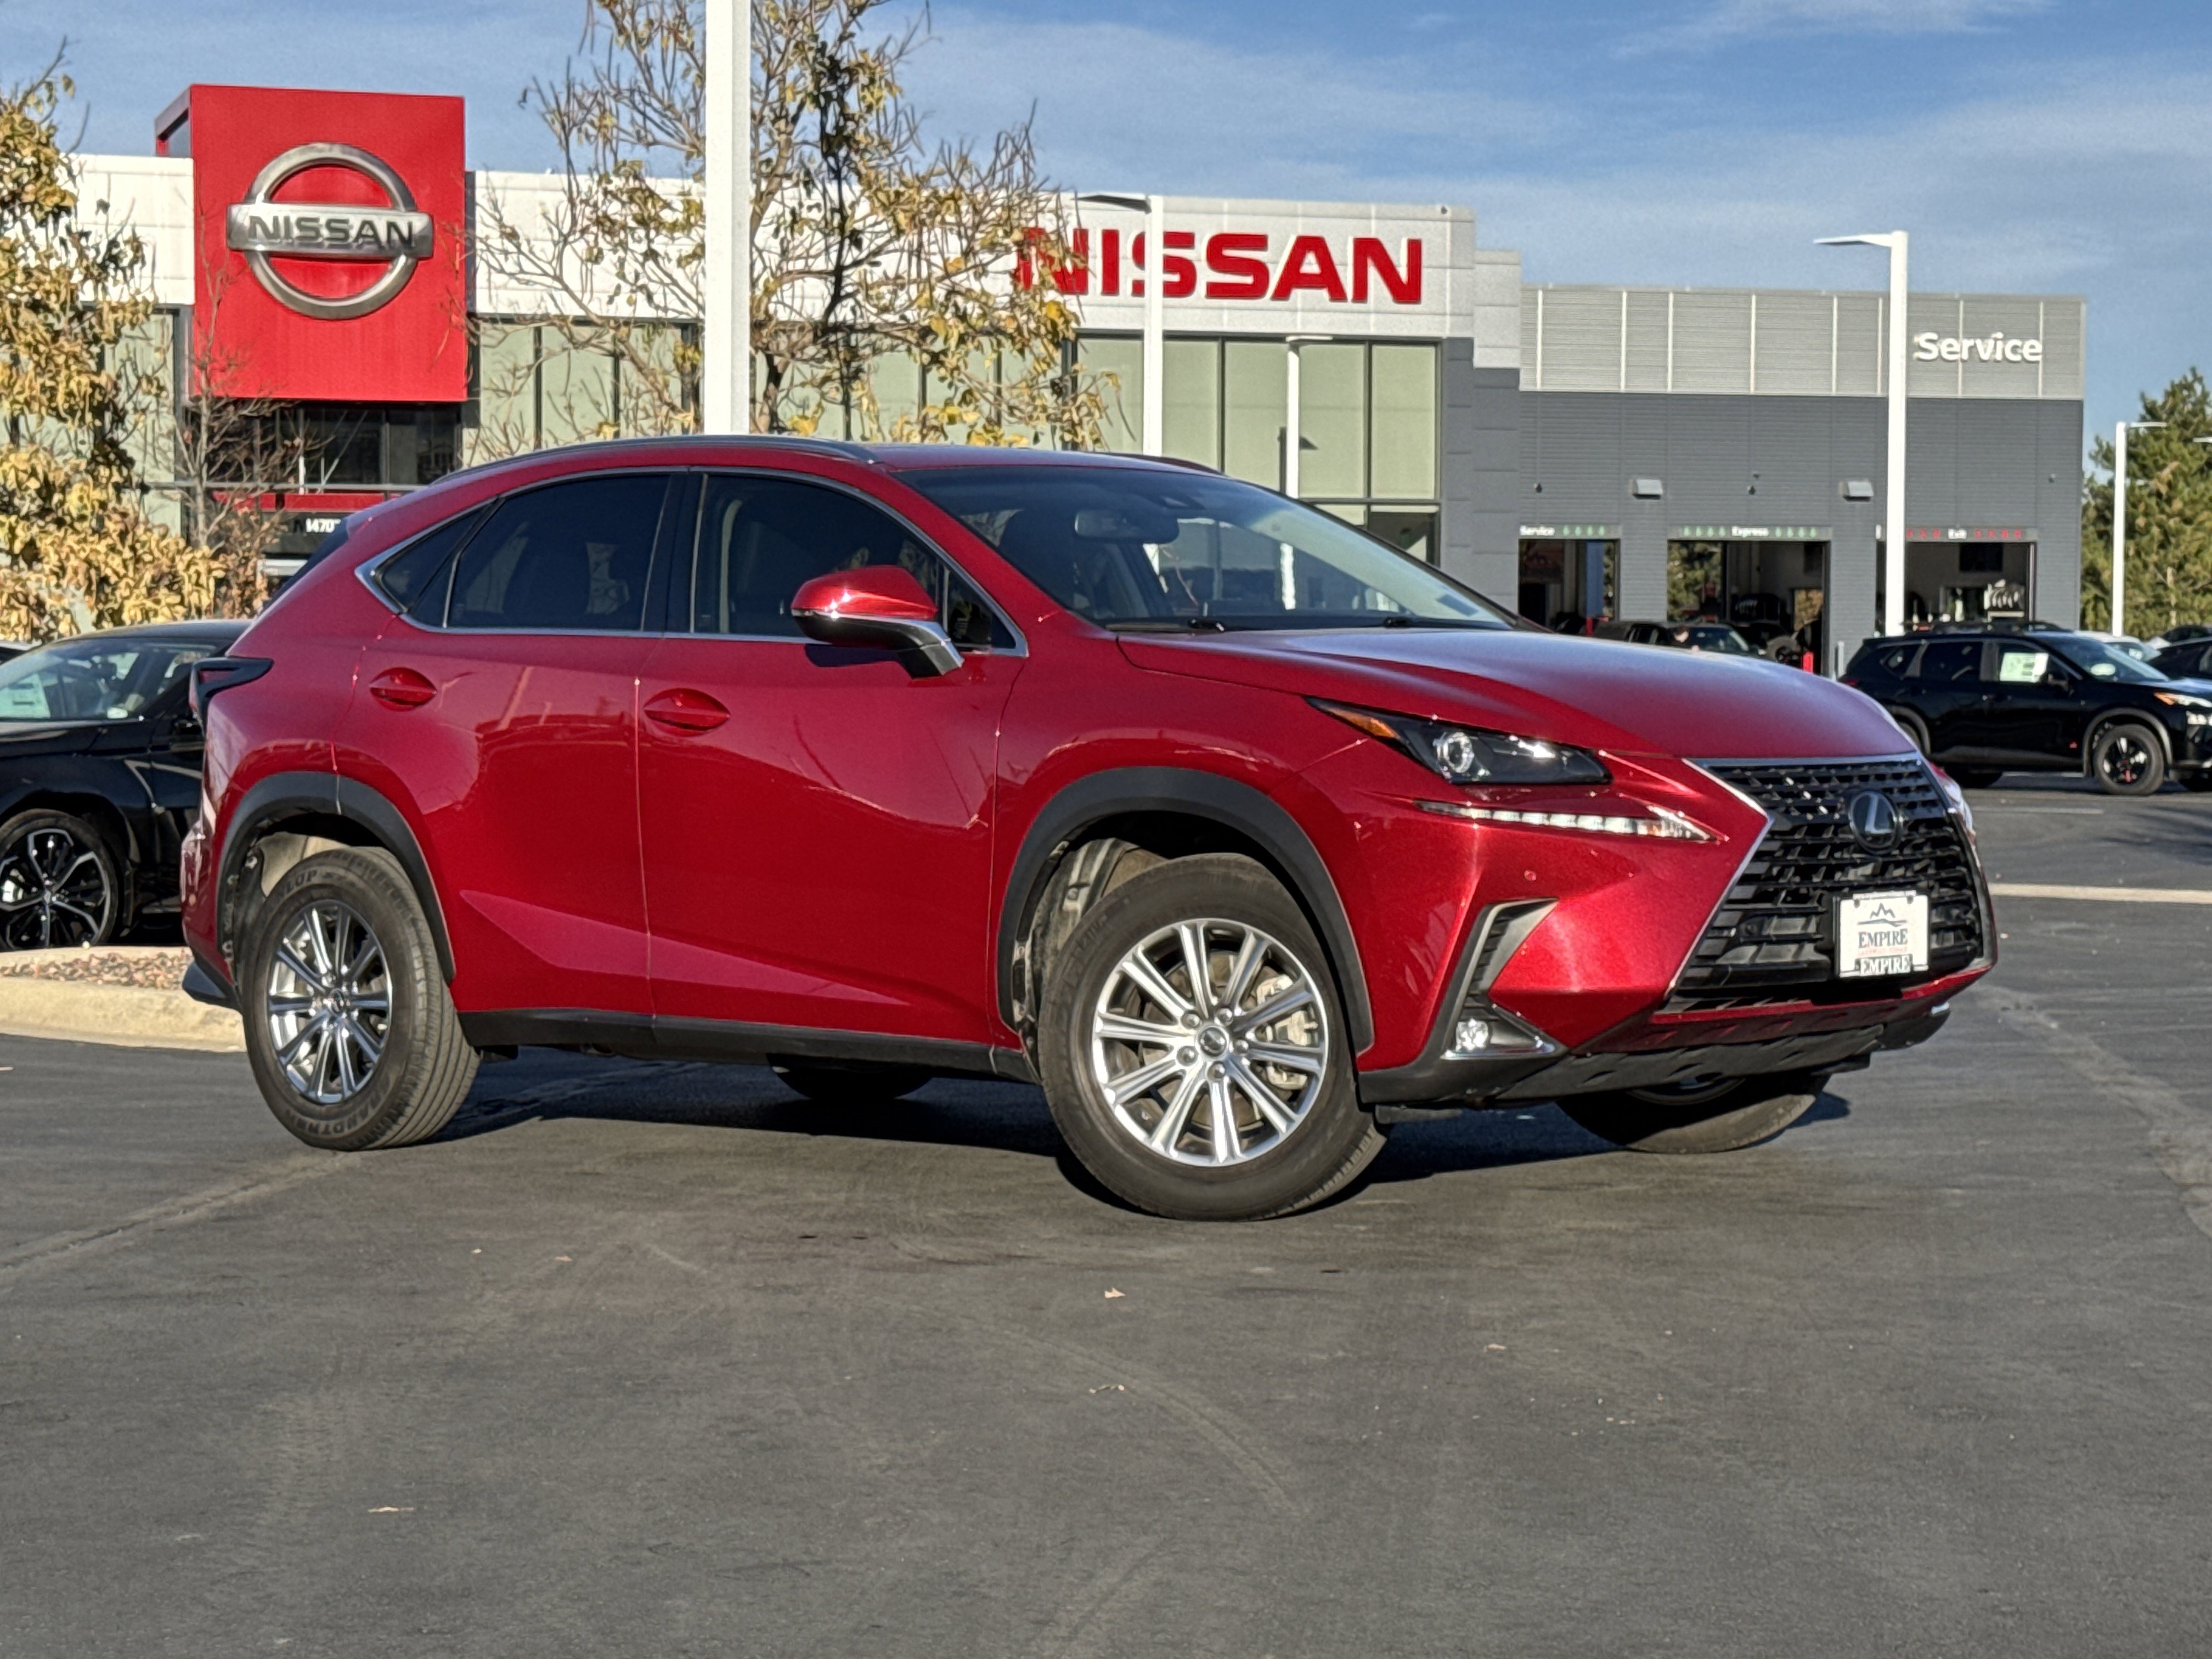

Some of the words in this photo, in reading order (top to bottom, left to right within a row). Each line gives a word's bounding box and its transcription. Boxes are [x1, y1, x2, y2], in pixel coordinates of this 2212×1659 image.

[249, 215, 414, 250] NISSAN
[1016, 227, 1423, 303] NISSAN
[1915, 331, 2042, 362] Service
[1858, 928, 1908, 949] EMPIRE
[1860, 955, 1911, 977] EMPIRE
